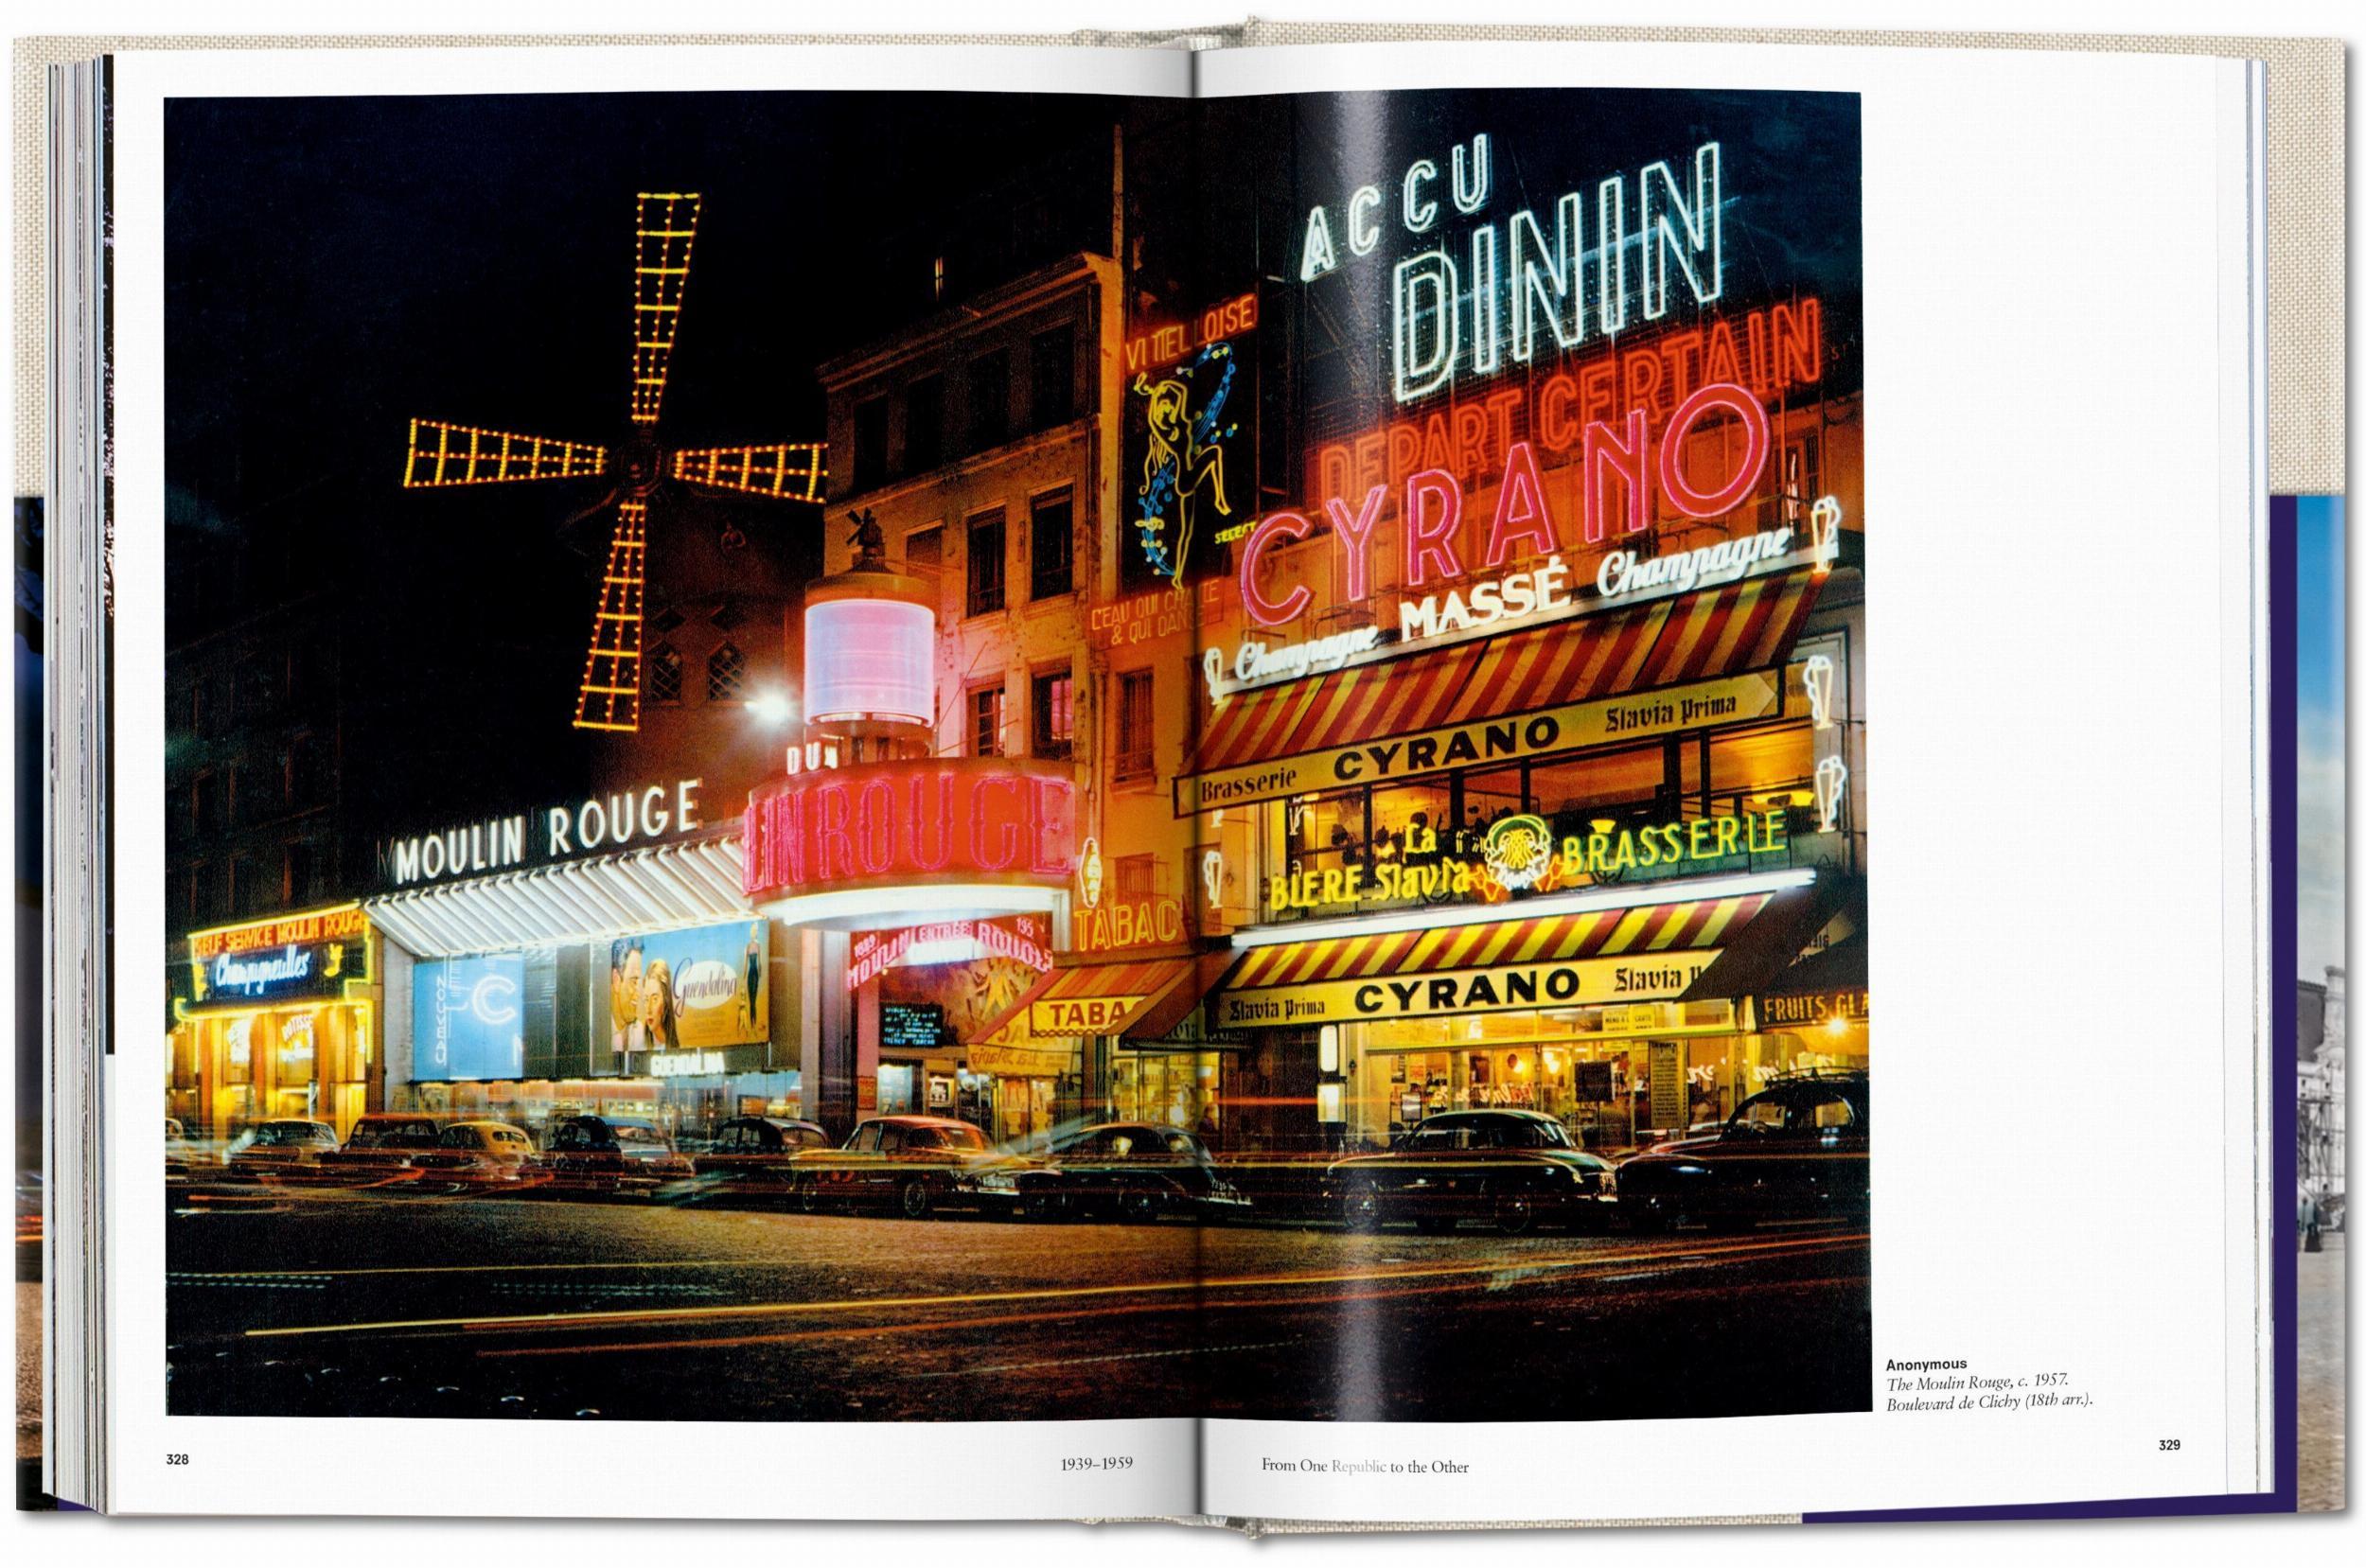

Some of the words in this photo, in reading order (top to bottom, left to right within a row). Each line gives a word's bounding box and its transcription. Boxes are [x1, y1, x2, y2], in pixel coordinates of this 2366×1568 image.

[1300, 133, 1491, 281] ACCU
[1393, 143, 1720, 402] DININ
[1540, 298, 1822, 451] CERTAIN
[1240, 382, 1771, 626] CYRANO
[1598, 526, 1792, 597] Champagne
[1400, 555, 1572, 645] MASSÉ
[1235, 625, 1378, 681] Champagne
[1200, 766, 1298, 805] Brasserie
[1333, 714, 1561, 782] CYRANO
[1605, 698, 1673, 733] Slavia
[1680, 692, 1737, 728] Prima
[394, 817, 523, 885] MOULIN
[549, 780, 702, 855] ROUGE
[817, 773, 1073, 880] ROUGE
[1404, 822, 1438, 864] La
[1562, 809, 1790, 879] BRASSERIE
[1372, 856, 1471, 902] Slavia
[226, 926, 274, 953] SERVICE
[277, 918, 320, 944] MOULIN
[978, 922, 1053, 973] ROUGE
[1074, 900, 1177, 952] TABAC
[848, 929, 909, 991] MOULIN
[1613, 964, 1683, 993] Slavia
[1049, 999, 1138, 1027] TABA
[1230, 996, 1280, 1022] Slavia
[1284, 995, 1326, 1021] Prima
[1354, 968, 1580, 1013] CYRANO
[1762, 995, 1827, 1023] FRUITS
[1886, 1359, 1968, 1372] Anonymous
[1887, 1378, 1912, 1391] The
[1916, 1375, 1965, 1390] Moulin
[1969, 1376, 2014, 1391] Rouge,
[2018, 1377, 2028, 1387] c.
[2034, 1373, 2069, 1387] 1957.
[1887, 1398, 1954, 1412] Boulevard
[1959, 1397, 1975, 1410] de
[1979, 1394, 2021, 1412] Clichy
[2025, 1393, 2058, 1409] (18th
[2062, 1392, 2093, 1408] arr.).
[166, 1453, 189, 1466] 328
[1061, 1455, 1134, 1471] 1939–1959
[1262, 1458, 1297, 1471] From
[1300, 1458, 1328, 1472] One
[1332, 1459, 1387, 1476] Republic
[1390, 1461, 1404, 1473] to
[1407, 1460, 1428, 1473] the
[1431, 1460, 1469, 1474] Other
[2159, 1438, 2181, 1452] 329
